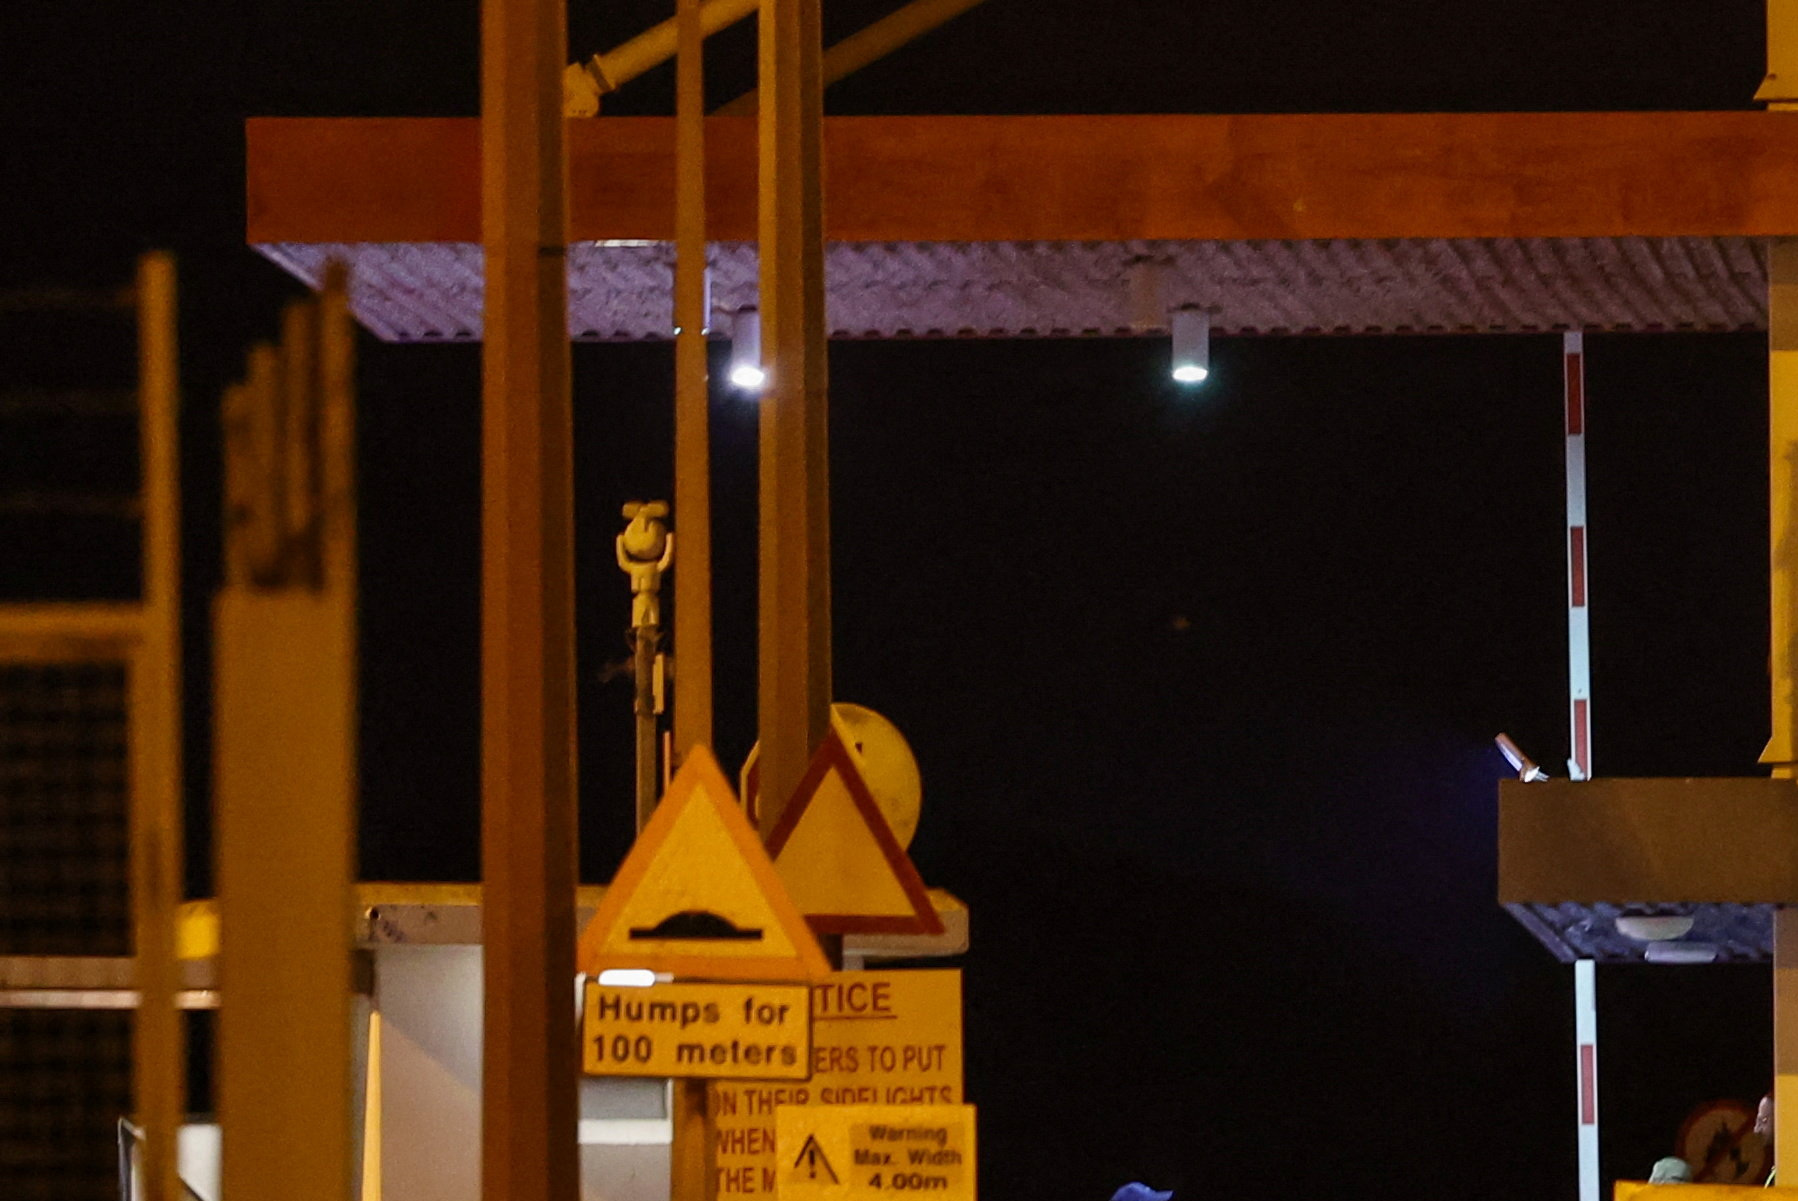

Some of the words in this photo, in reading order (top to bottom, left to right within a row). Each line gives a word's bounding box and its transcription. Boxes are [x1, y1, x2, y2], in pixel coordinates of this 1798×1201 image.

[598, 994, 719, 1030] Humps
[744, 997, 790, 1026] for
[814, 982, 892, 1014] TICE
[592, 1034, 653, 1063] 100
[676, 1040, 798, 1067] meters
[814, 1046, 860, 1074] ERS
[869, 1045, 896, 1073] TO
[902, 1043, 947, 1072] PUT
[868, 1125, 948, 1148] Warning
[907, 1149, 963, 1166] Width
[868, 1172, 948, 1191] 4.00m
